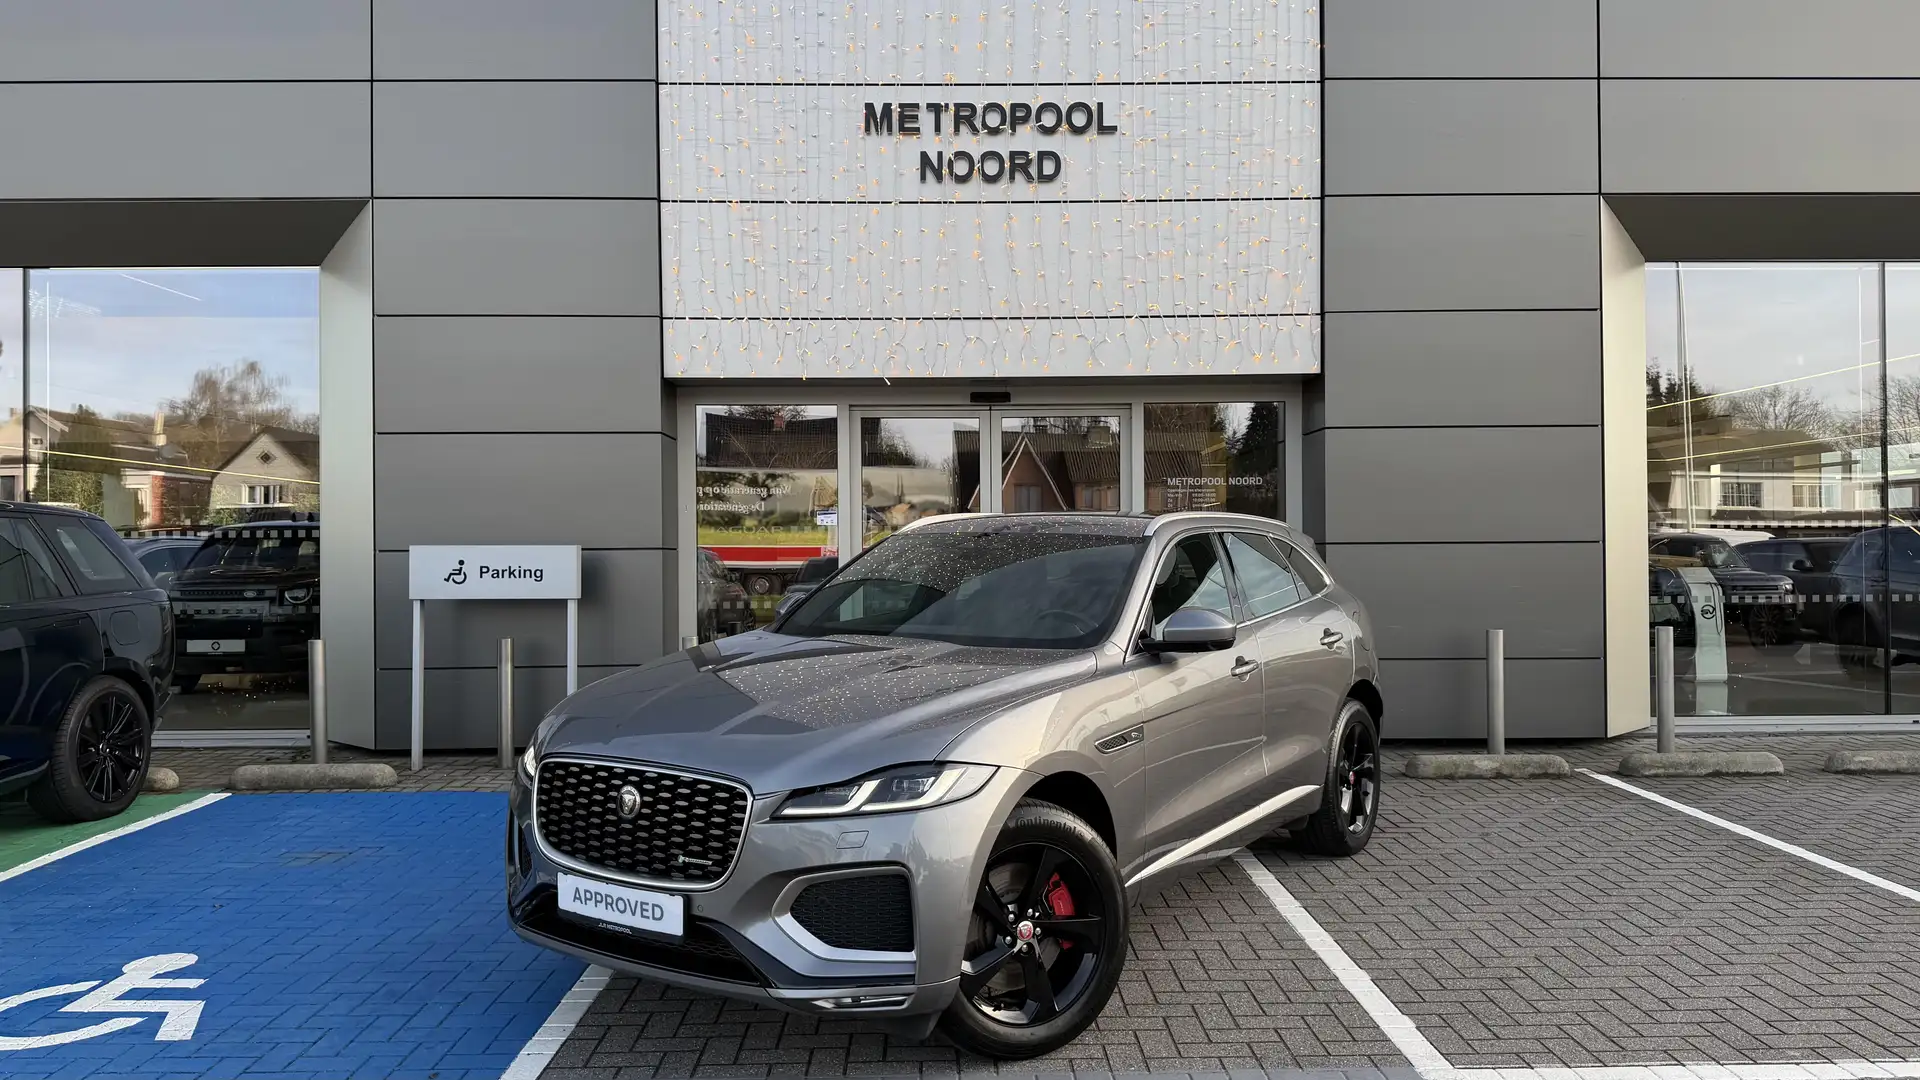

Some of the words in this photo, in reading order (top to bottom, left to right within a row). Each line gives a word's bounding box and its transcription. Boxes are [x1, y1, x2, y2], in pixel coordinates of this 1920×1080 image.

[864, 101, 1118, 136] METROPOOL
[919, 150, 1062, 183] NOORD
[1167, 477, 1227, 486] METROPOOL
[1228, 476, 1263, 485] NOORD
[479, 565, 544, 582] Parking
[572, 886, 665, 921] APPROVED
